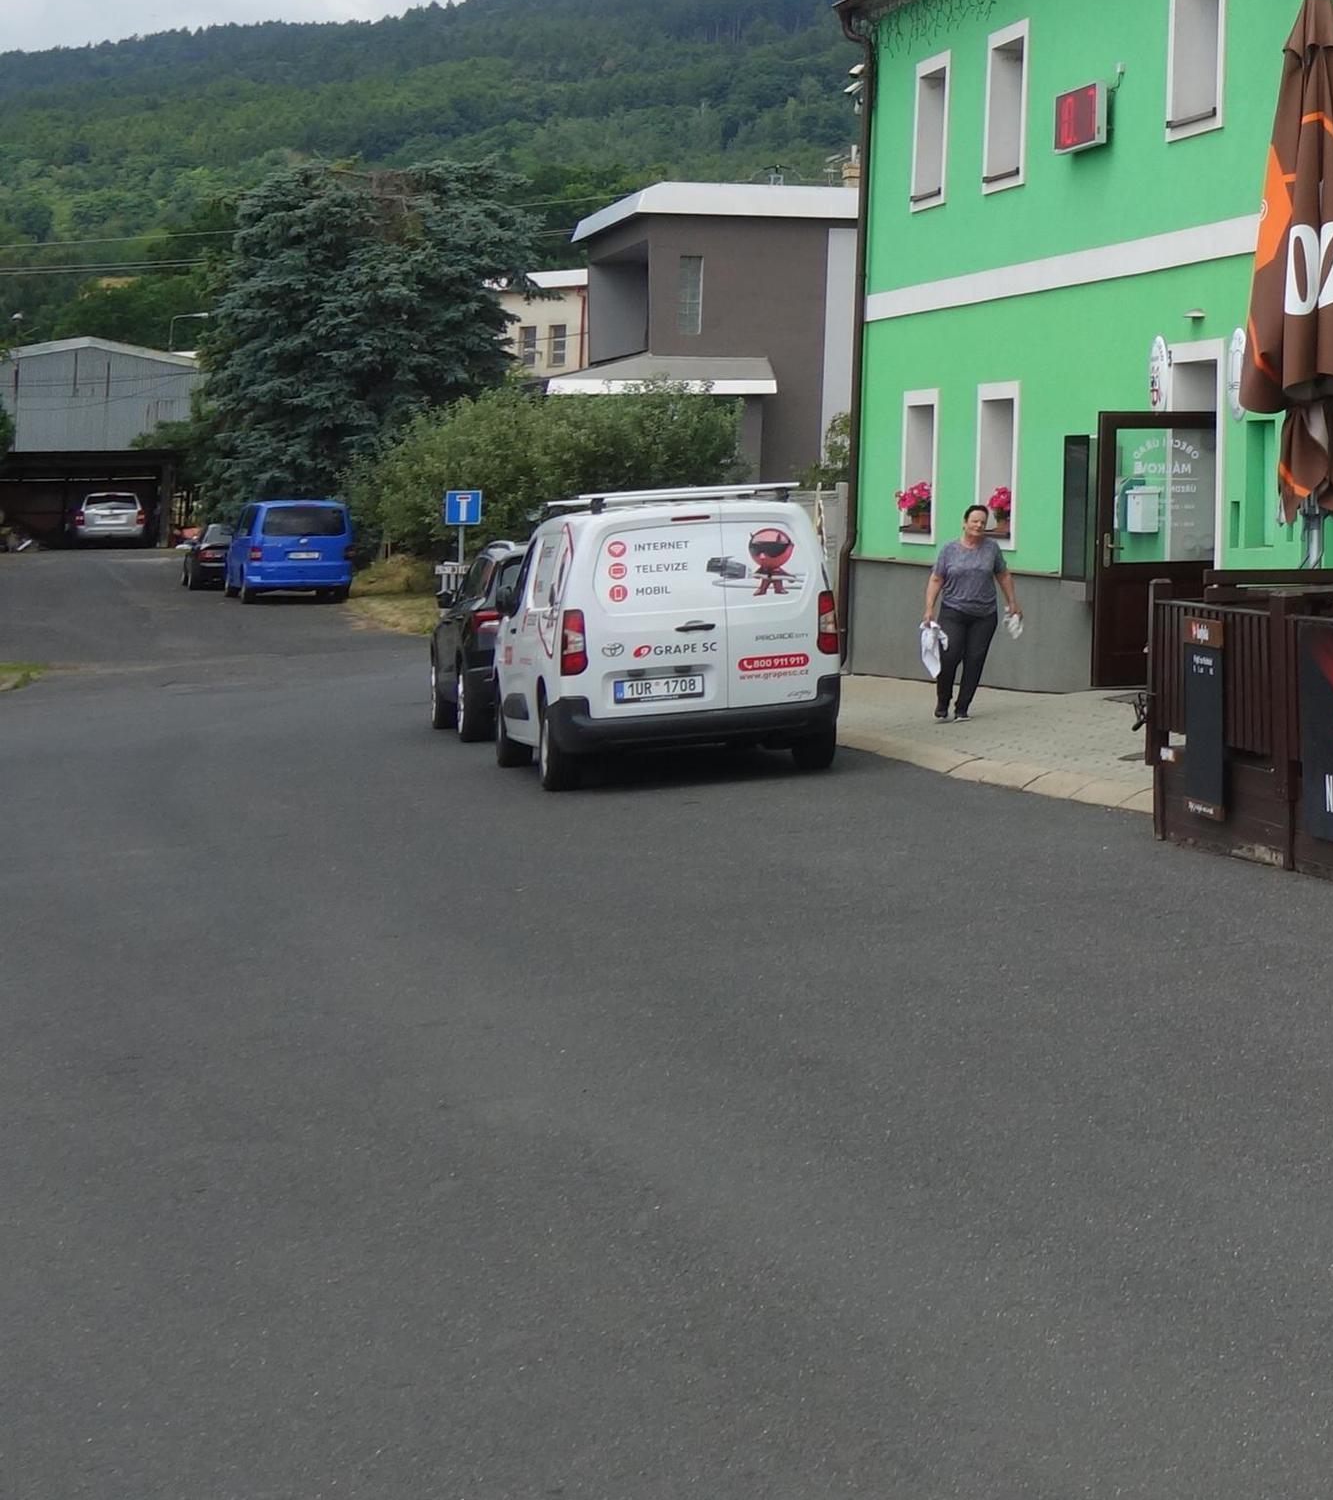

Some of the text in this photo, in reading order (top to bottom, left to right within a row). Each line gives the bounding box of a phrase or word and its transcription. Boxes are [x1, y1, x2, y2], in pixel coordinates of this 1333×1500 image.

[634, 540, 690, 552] INTERNET
[635, 562, 689, 574] TELEVIZE
[635, 586, 672, 597] MOBIL
[653, 642, 718, 656] GRAPE SC
[753, 656, 805, 668] 800 911 911
[739, 669, 809, 681] www.grapesc.cz
[628, 682, 652, 697] 1UR
[664, 678, 697, 694] 1708
